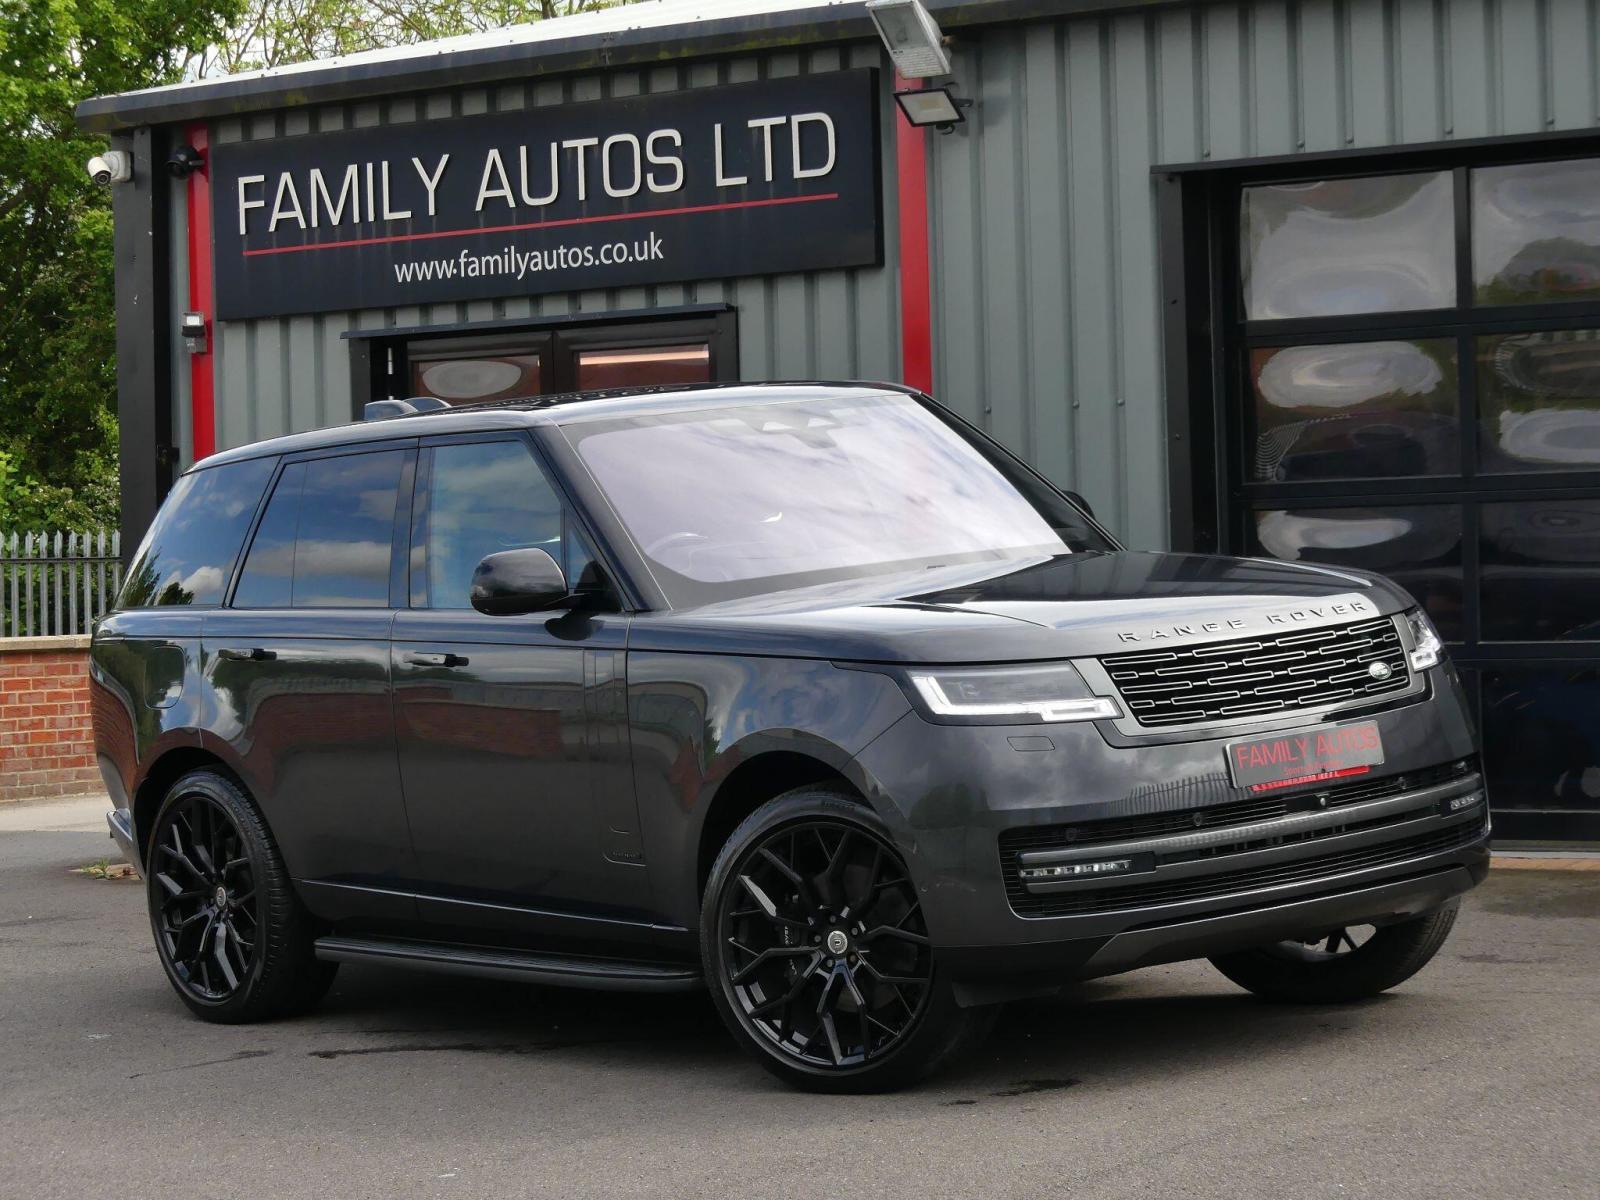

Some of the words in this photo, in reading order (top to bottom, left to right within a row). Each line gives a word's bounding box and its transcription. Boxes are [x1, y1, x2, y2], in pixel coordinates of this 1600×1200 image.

[238, 154, 449, 235] FAMILY
[476, 129, 683, 211] AUTOS
[715, 112, 835, 186] LTD
[395, 232, 663, 282] www.familyautos.co.uk
[1118, 619, 1248, 643] RANGE
[1266, 602, 1367, 625] ROVER
[1237, 735, 1310, 769] FAMILY
[1316, 725, 1378, 757] AUTOS
